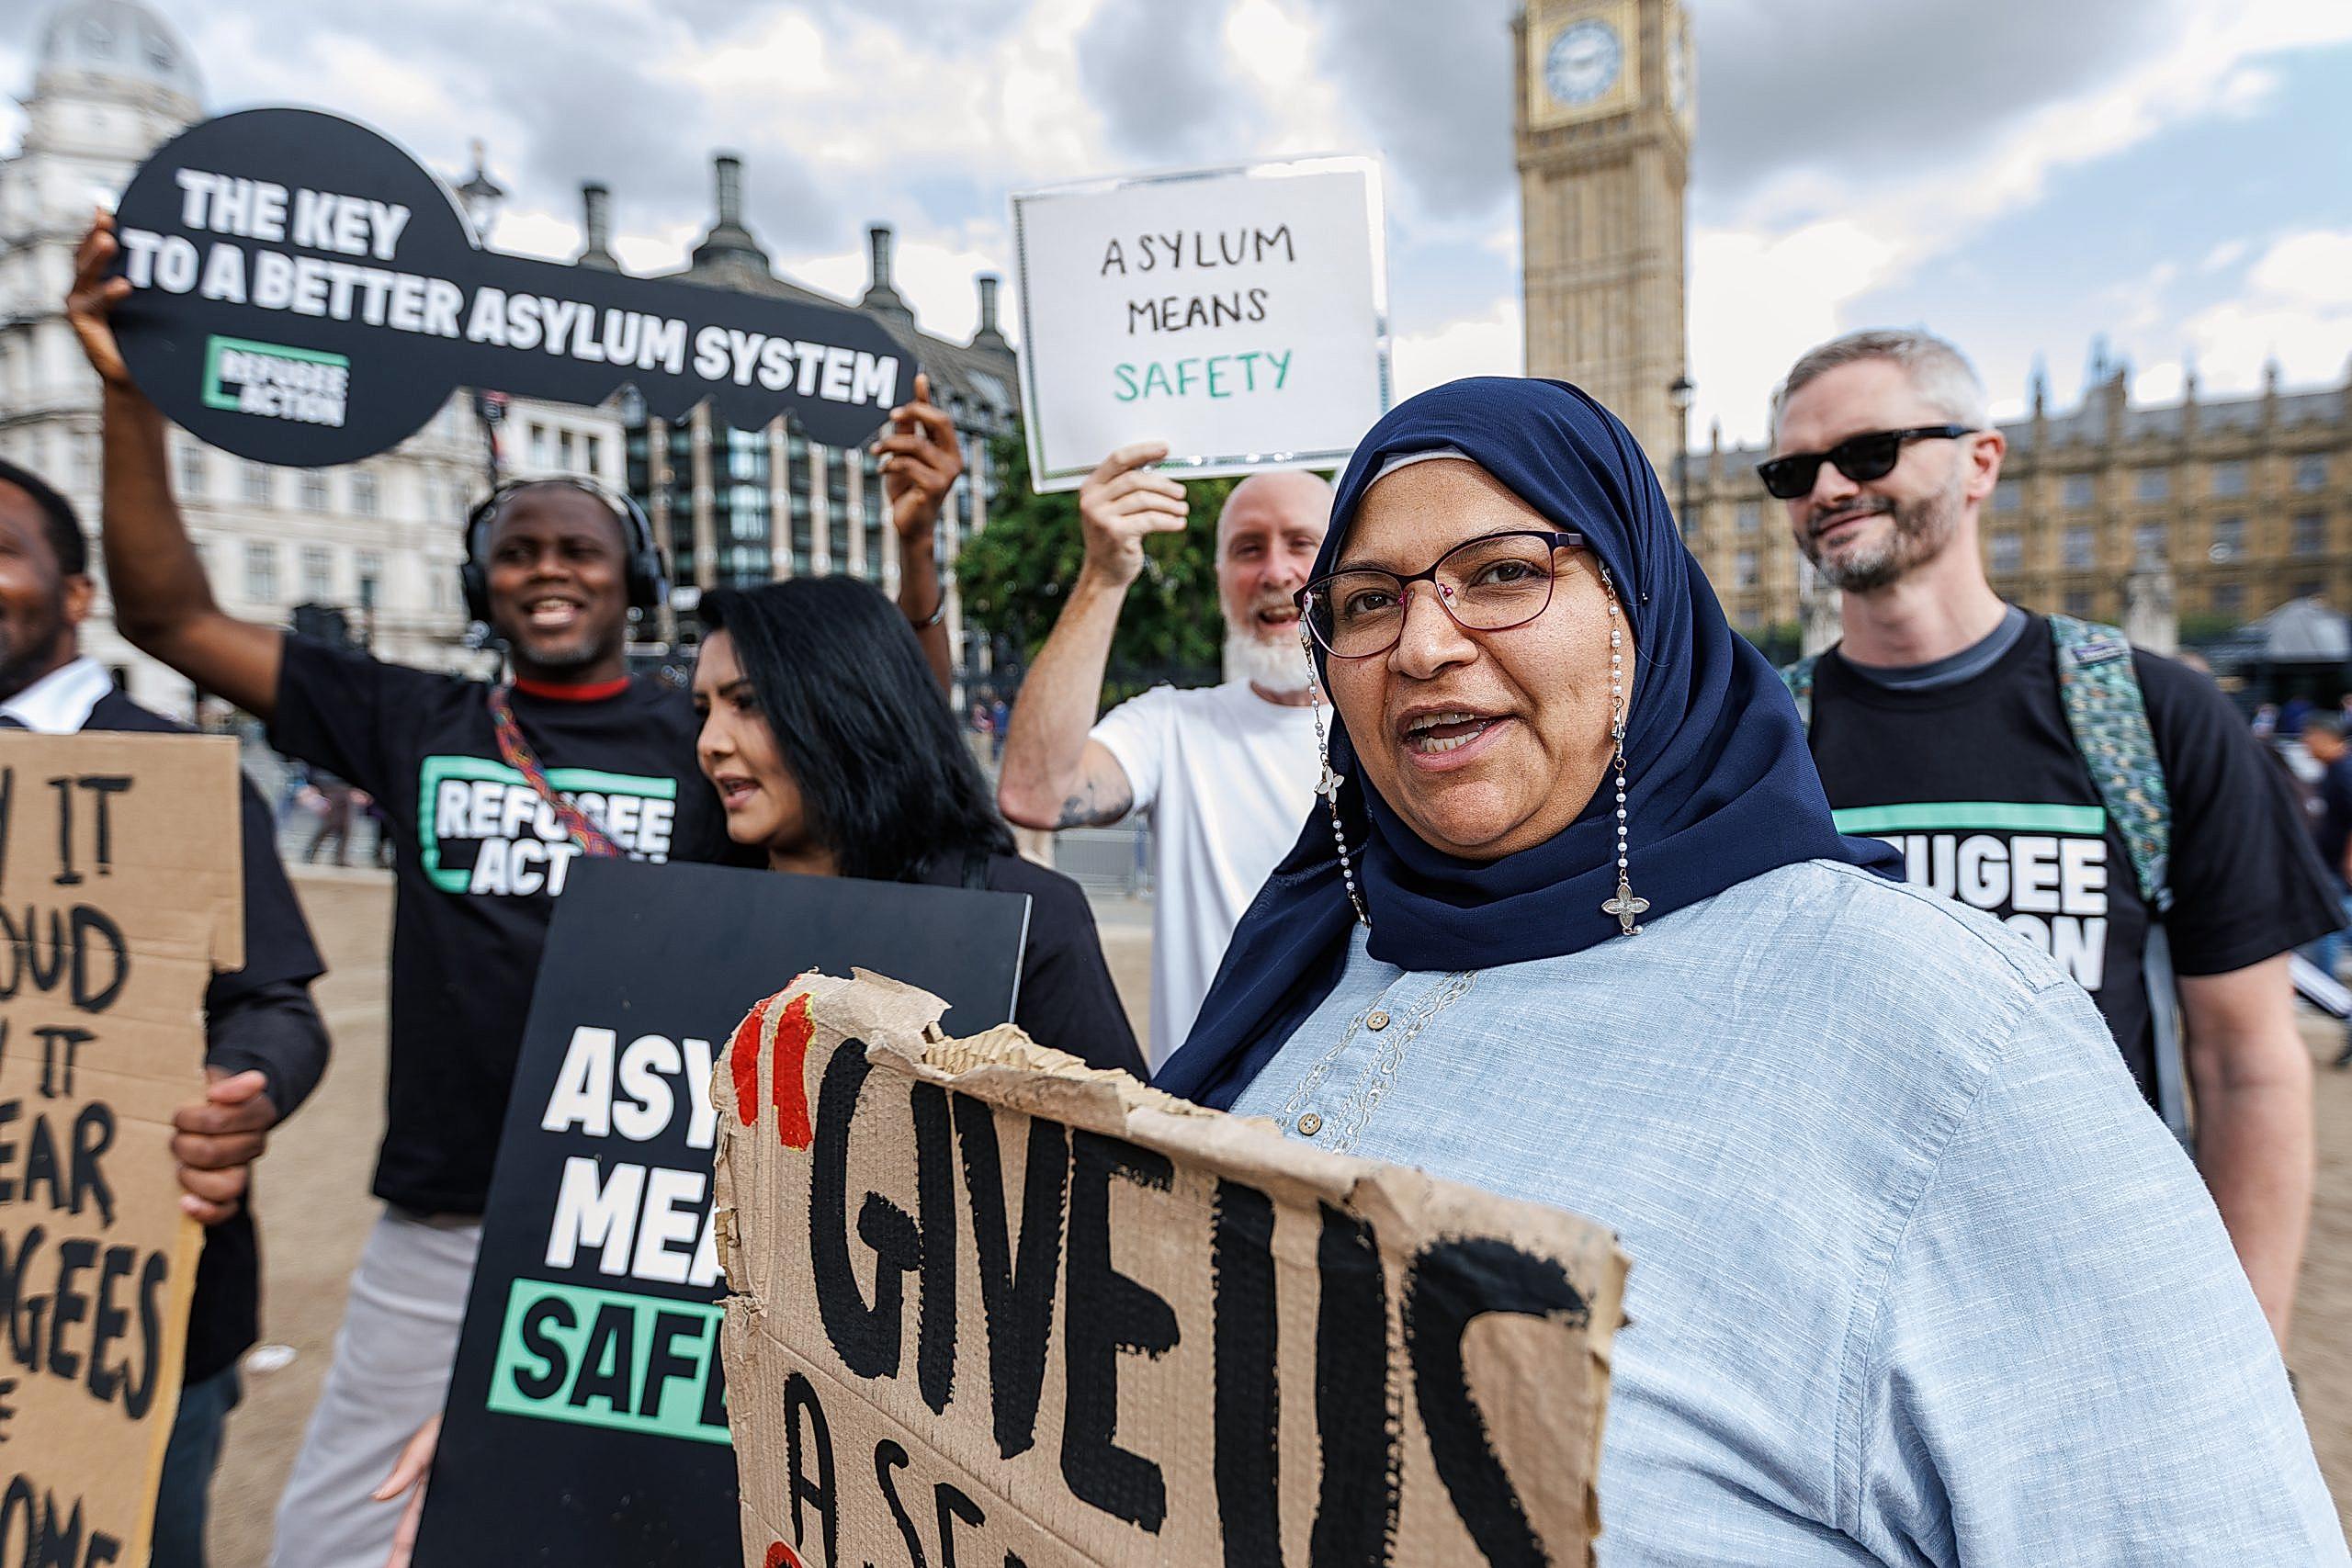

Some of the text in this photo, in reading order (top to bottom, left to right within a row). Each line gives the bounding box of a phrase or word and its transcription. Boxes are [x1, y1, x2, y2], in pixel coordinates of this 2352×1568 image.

[175, 167, 412, 261] THE KEY
[1102, 223, 1296, 276] ASYLUM
[119, 227, 899, 410] TO A BETTER ASYLUM SYSTEM
[1128, 288, 1269, 335] MEANS
[1114, 349, 1293, 402] SAFETY
[48, 775, 135, 886] IT
[34, 1027, 98, 1100] IT
